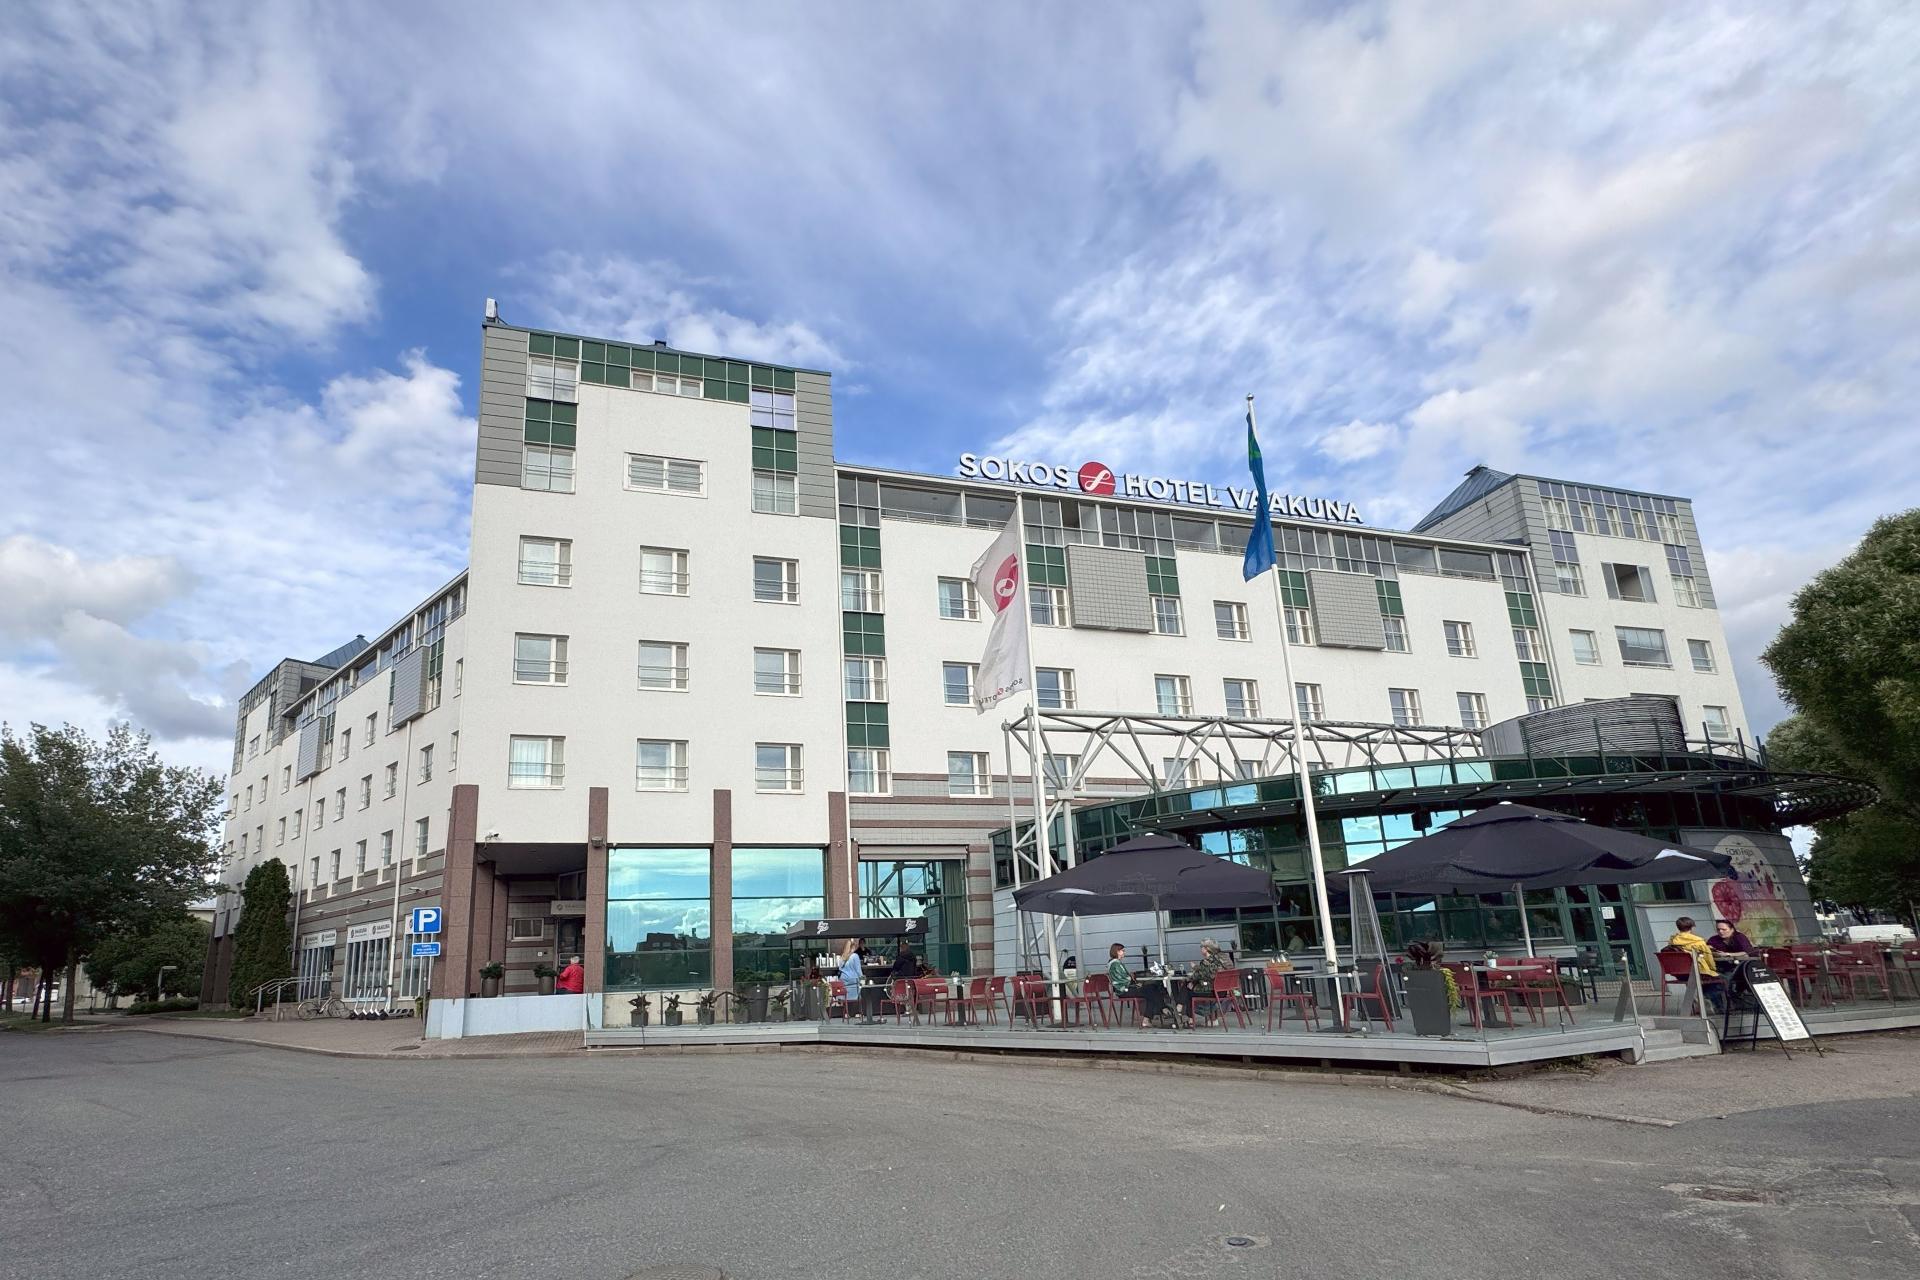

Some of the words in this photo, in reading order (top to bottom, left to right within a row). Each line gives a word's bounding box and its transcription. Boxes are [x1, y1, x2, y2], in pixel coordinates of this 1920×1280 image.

[960, 453, 1072, 489] SOKOS
[1124, 473, 1222, 507] HOTEL
[419, 910, 437, 932] P
